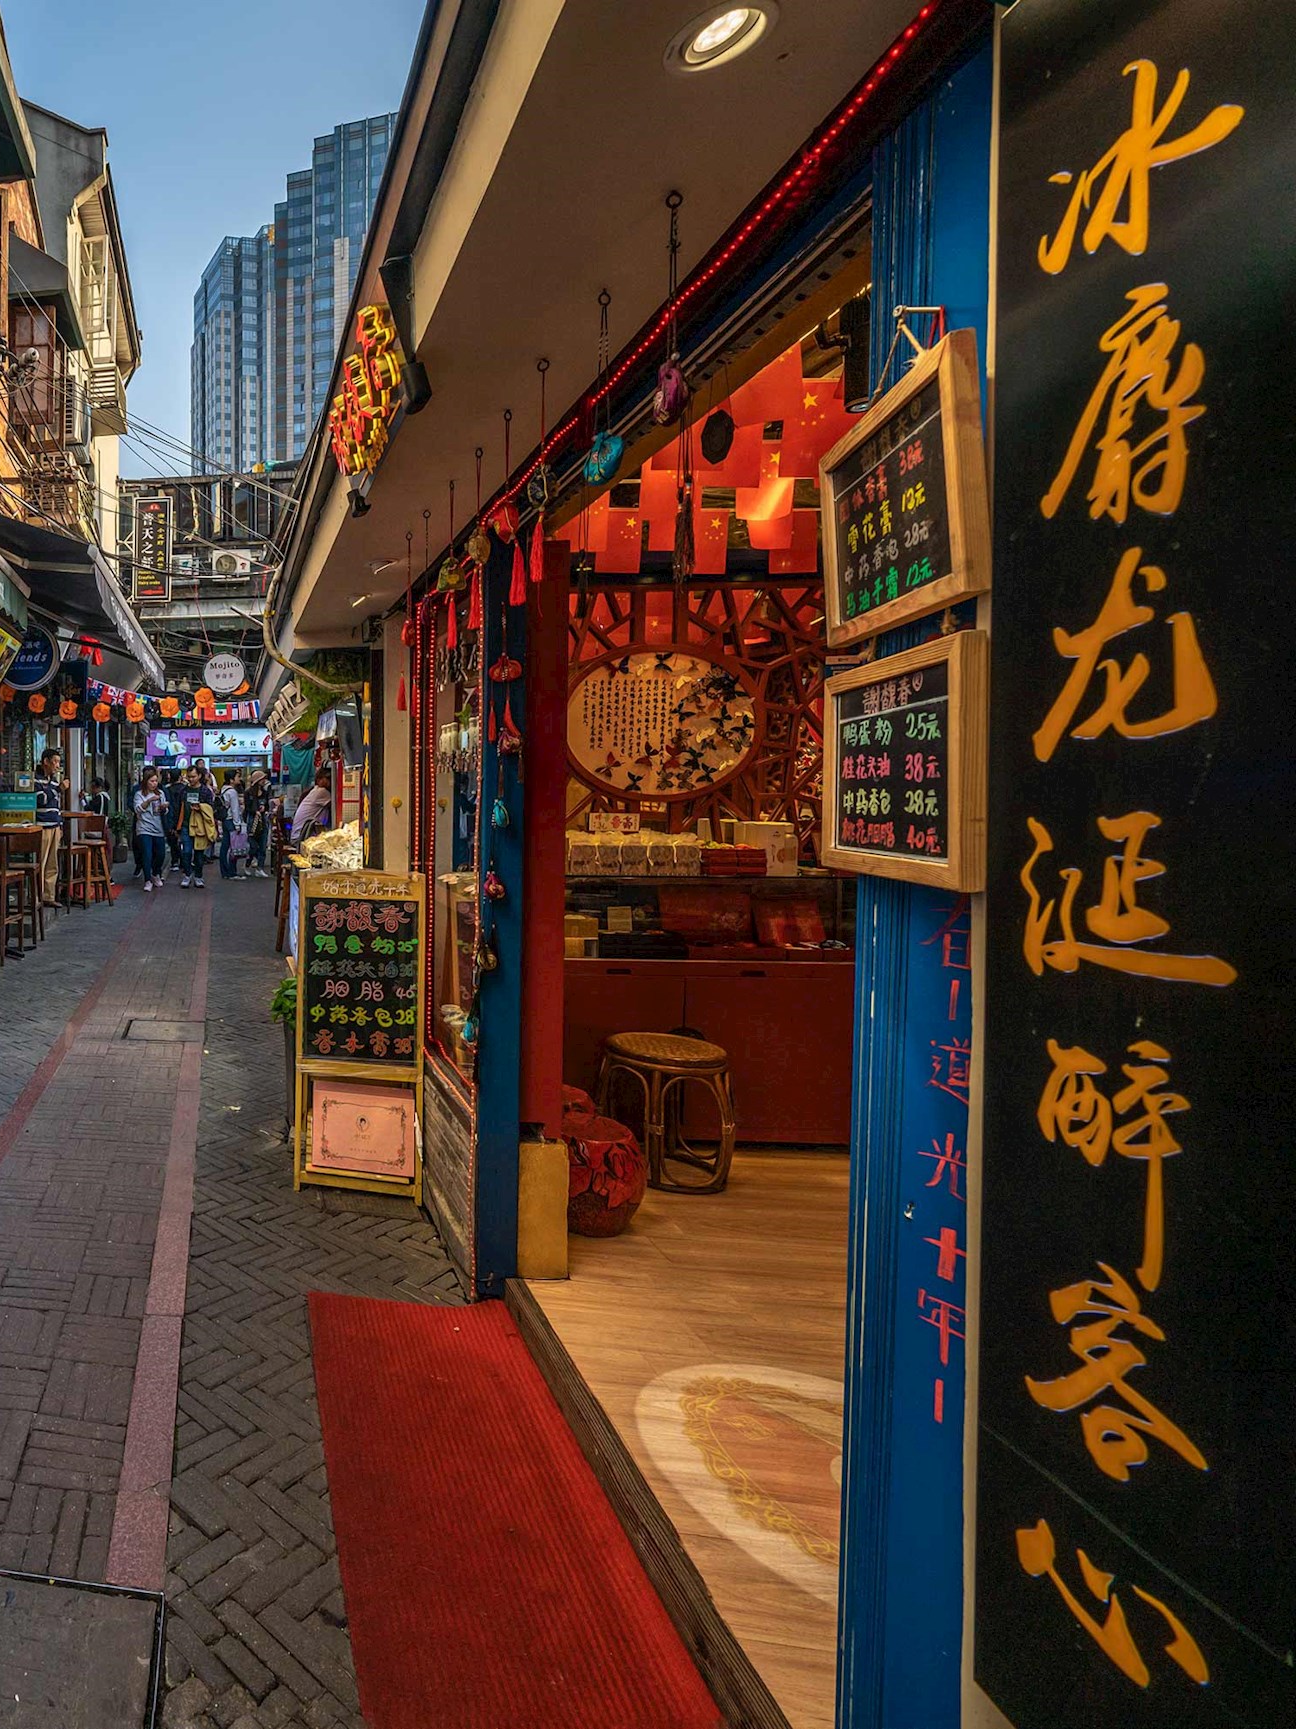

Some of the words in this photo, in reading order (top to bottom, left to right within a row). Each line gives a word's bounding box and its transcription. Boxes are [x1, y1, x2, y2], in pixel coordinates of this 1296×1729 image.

[906, 557, 933, 587] 12元
[210, 661, 240, 670] Mojito
[843, 717, 893, 747] 鸭蛋粉
[905, 712, 941, 741] 25元
[905, 752, 941, 783] 38元
[843, 788, 891, 816] 中药香包
[904, 789, 939, 817] 28元
[906, 824, 941, 854] 40元
[320, 979, 384, 1002] 胭脂
[310, 1004, 393, 1028] 中药香包
